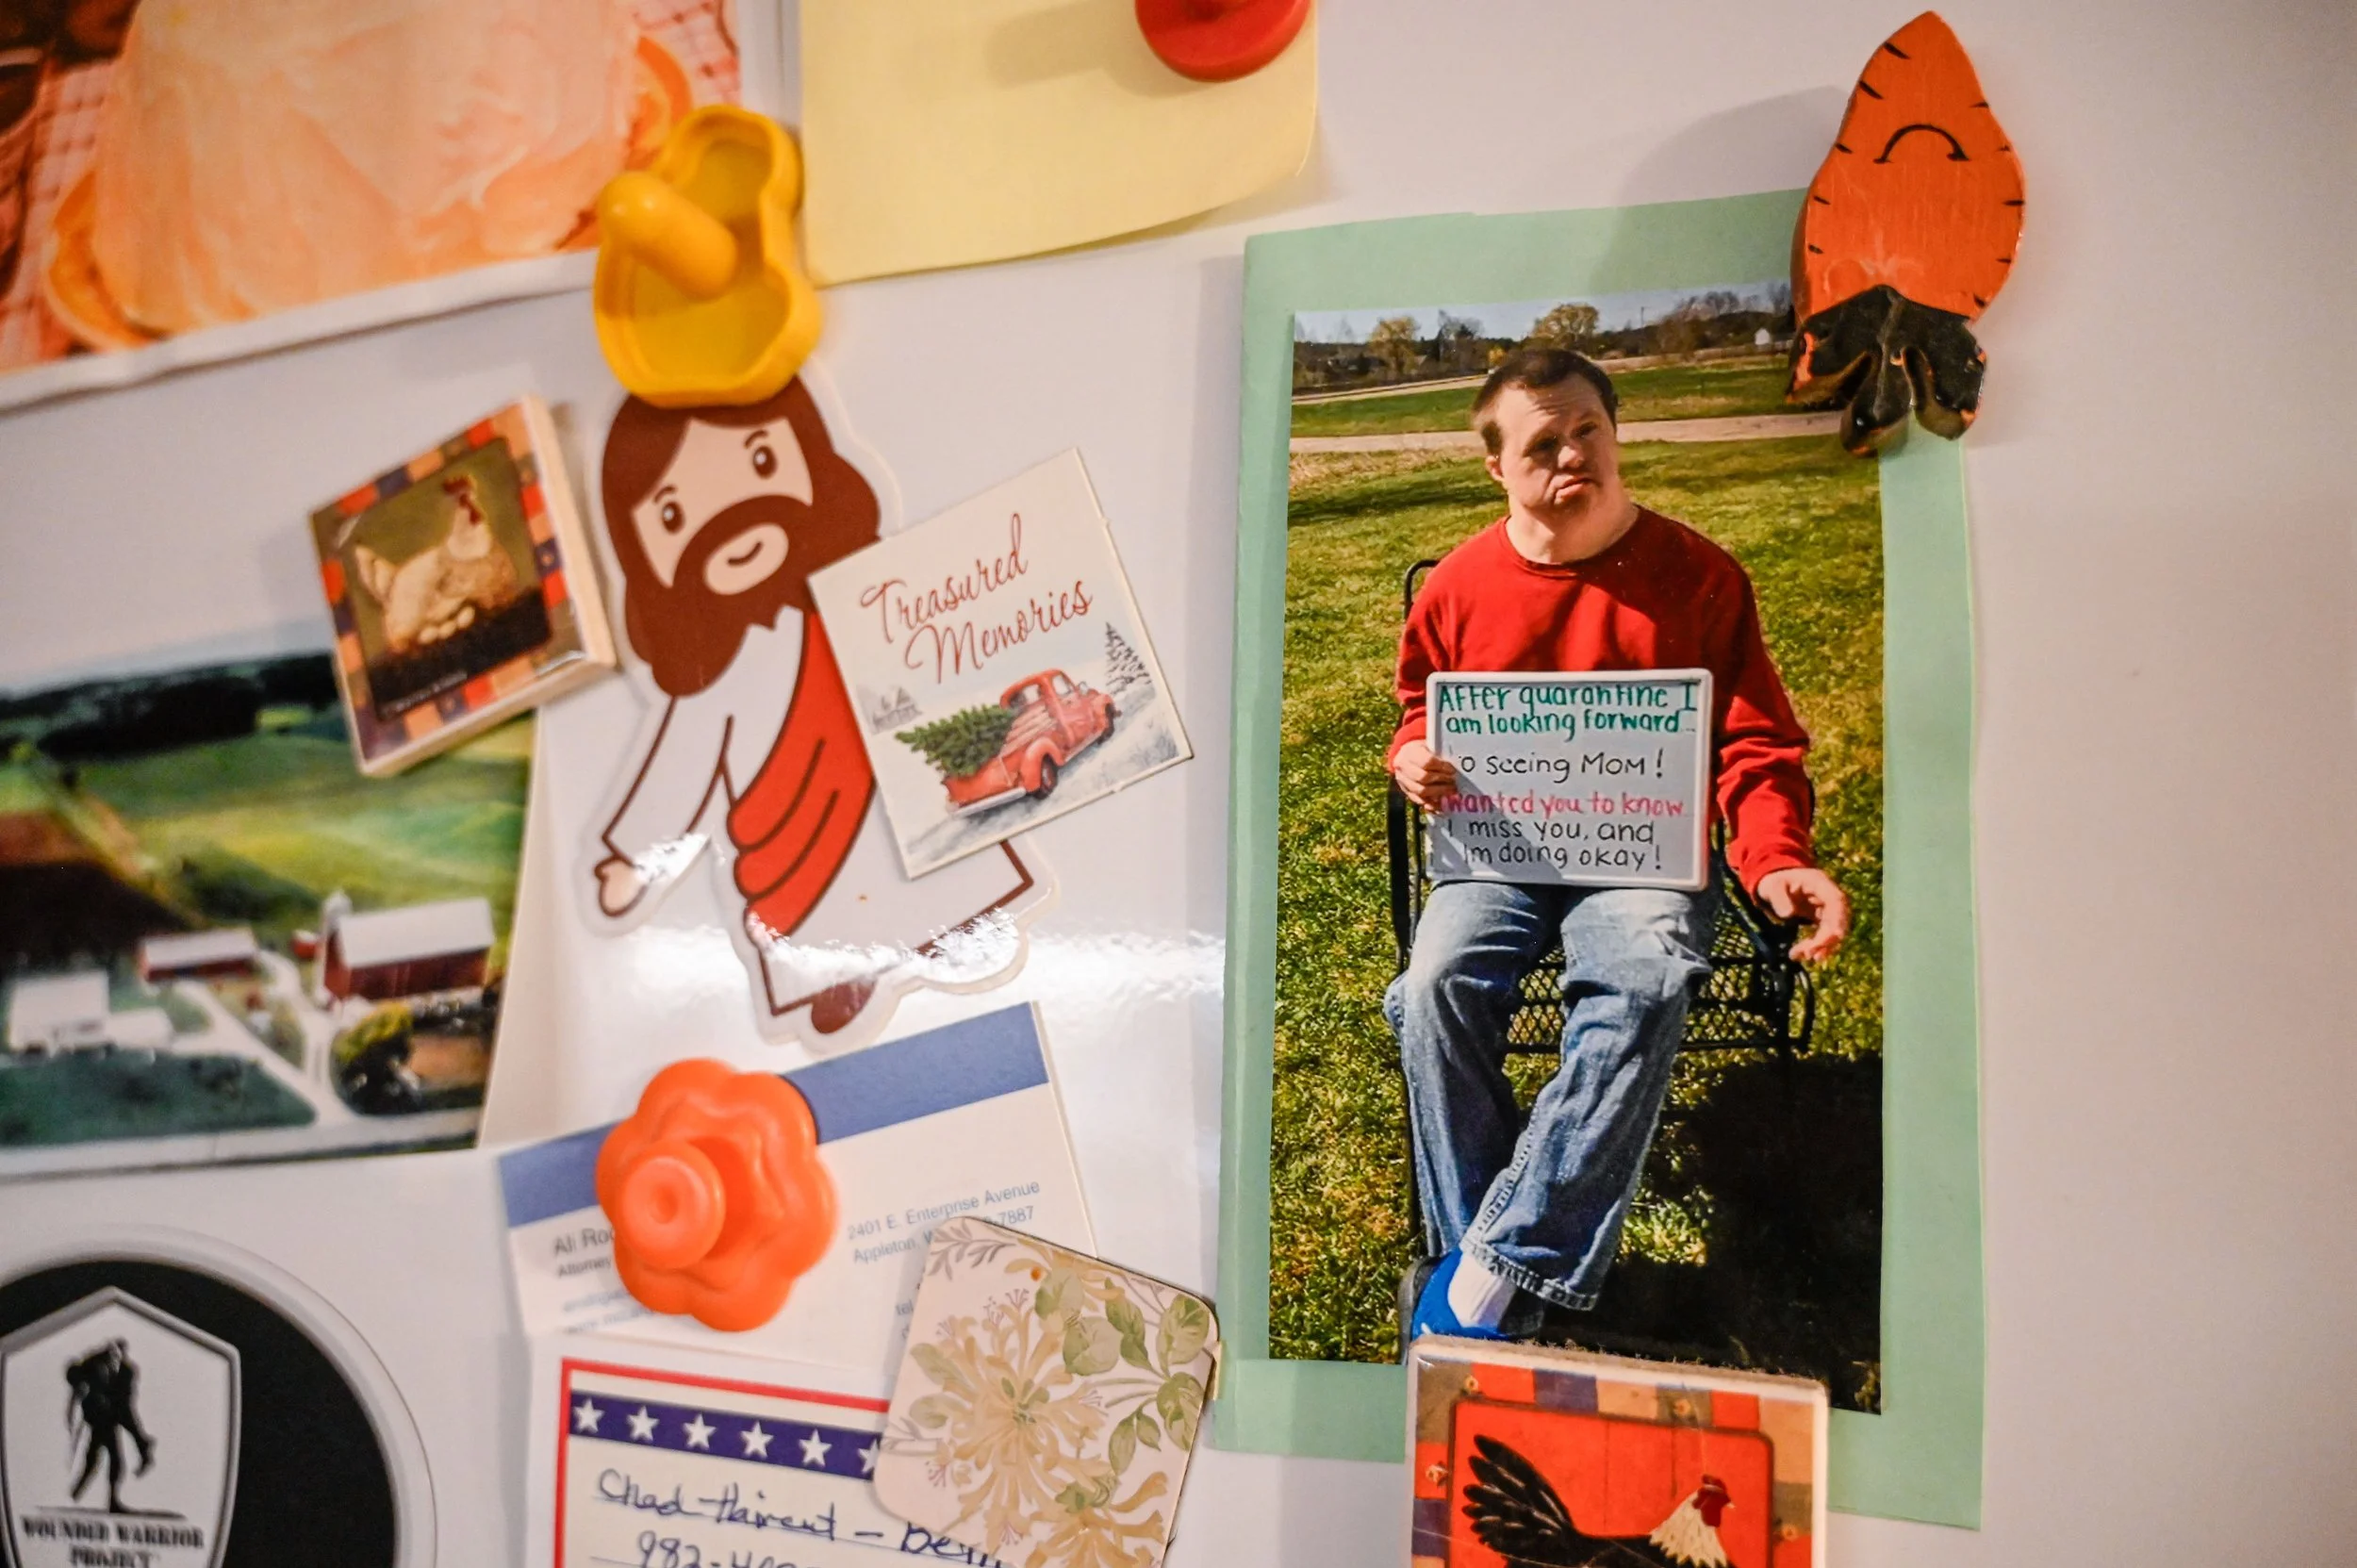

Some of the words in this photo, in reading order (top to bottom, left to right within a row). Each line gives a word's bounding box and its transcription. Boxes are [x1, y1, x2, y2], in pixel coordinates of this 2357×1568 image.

[860, 512, 1029, 644] Treasured
[904, 579, 1094, 685] Memories
[1519, 684, 1668, 718] quarantine
[1680, 681, 1700, 712] I
[1445, 717, 1481, 734] am
[1488, 712, 1575, 743] looking
[1486, 751, 1571, 784] seeing
[1539, 794, 1584, 819] you
[1591, 791, 1615, 815] to
[1622, 791, 1685, 817] know
[1447, 818, 1453, 838] I
[1468, 819, 1524, 839] miss
[1533, 820, 1589, 842] you,
[1597, 819, 1656, 846] and
[1498, 841, 1569, 870] doing
[848, 1218, 882, 1241] 2401
[905, 1195, 981, 1226] Enterprise
[983, 1180, 1041, 1206] Avenue
[557, 1255, 612, 1280] Attorney
[22, 1517, 109, 1540] WOUNDED
[116, 1524, 205, 1548] WARRIOR
[70, 1545, 155, 1568] PROJECT
